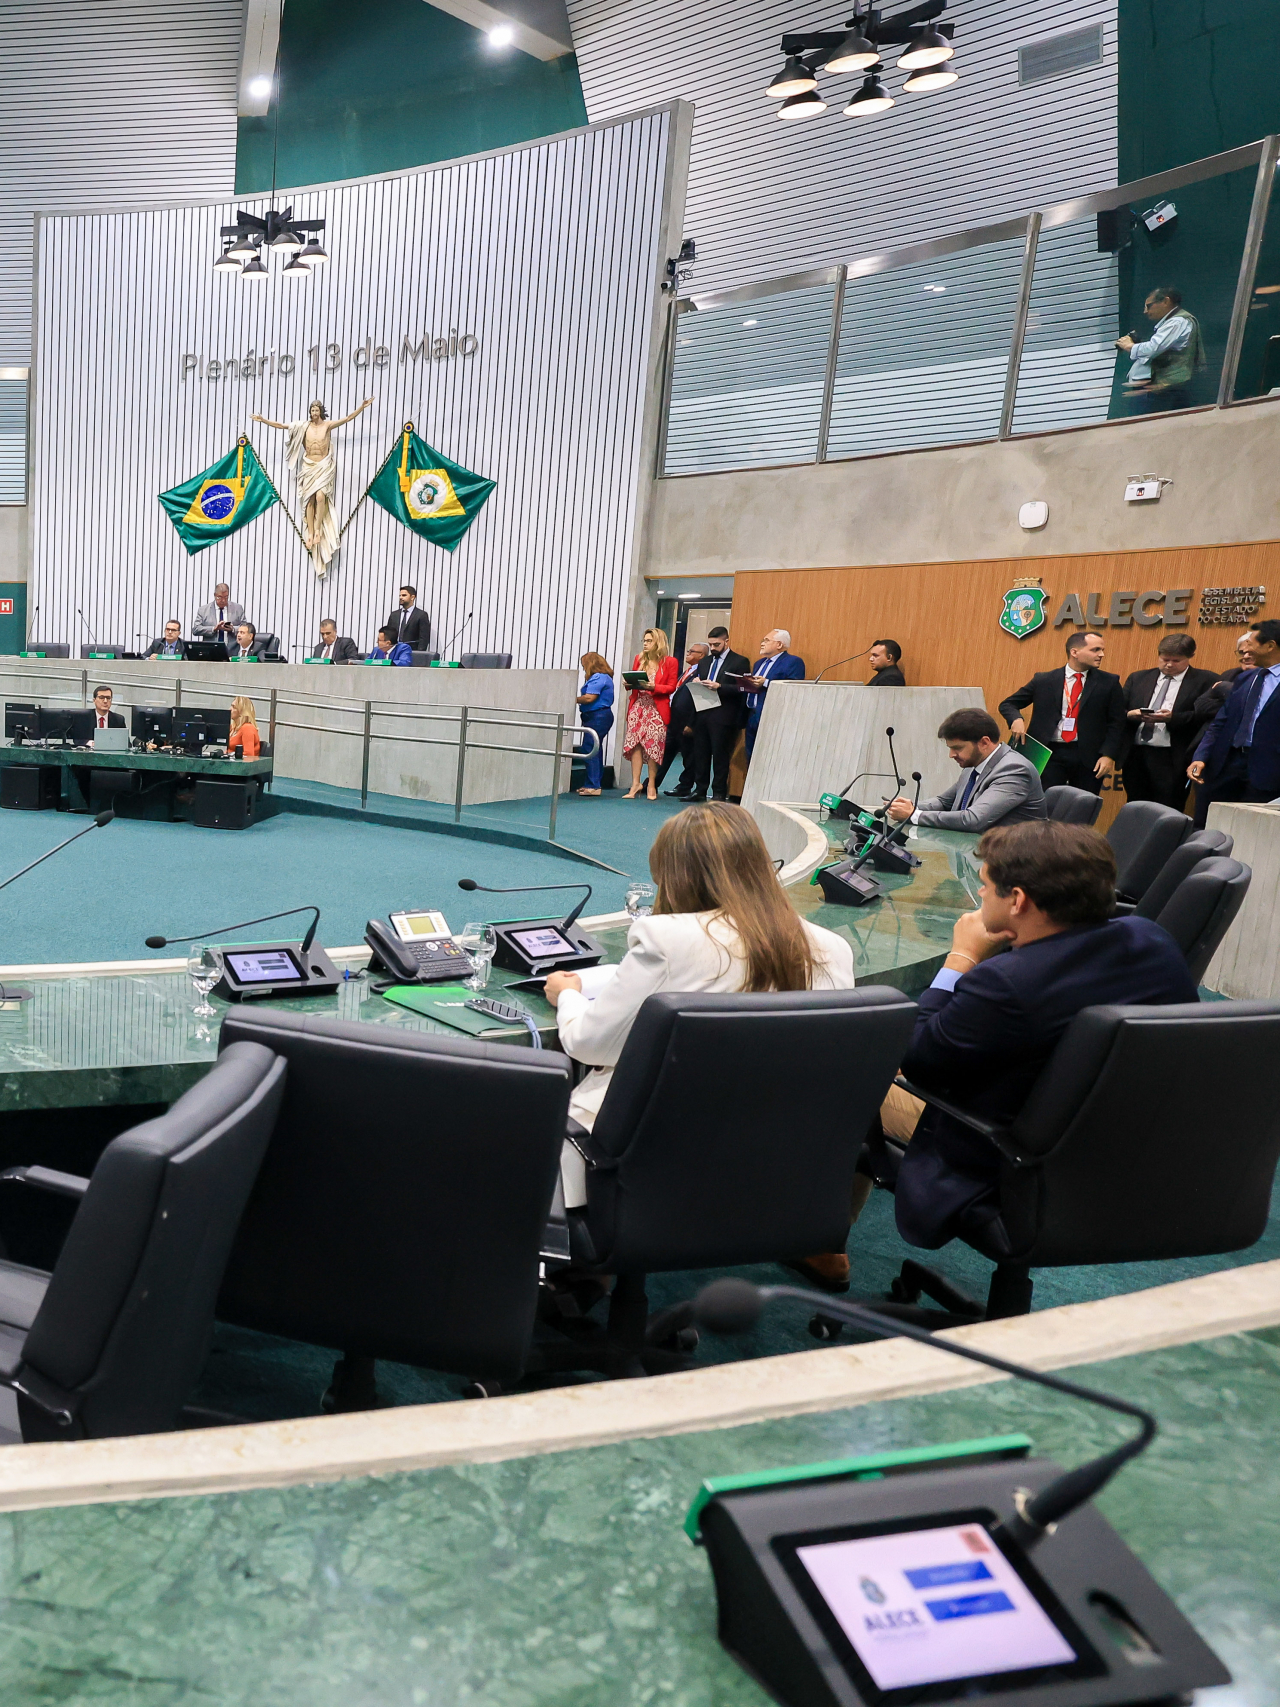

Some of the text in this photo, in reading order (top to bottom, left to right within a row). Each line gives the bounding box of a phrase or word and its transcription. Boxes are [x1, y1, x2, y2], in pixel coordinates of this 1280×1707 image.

[182, 328, 479, 382] Plenário 13 de Maio
[1200, 595, 1266, 605] LEGISLATIVA
[1, 602, 10, 611] H
[1052, 589, 1194, 626] ALECE
[1215, 605, 1257, 614] ESTADO
